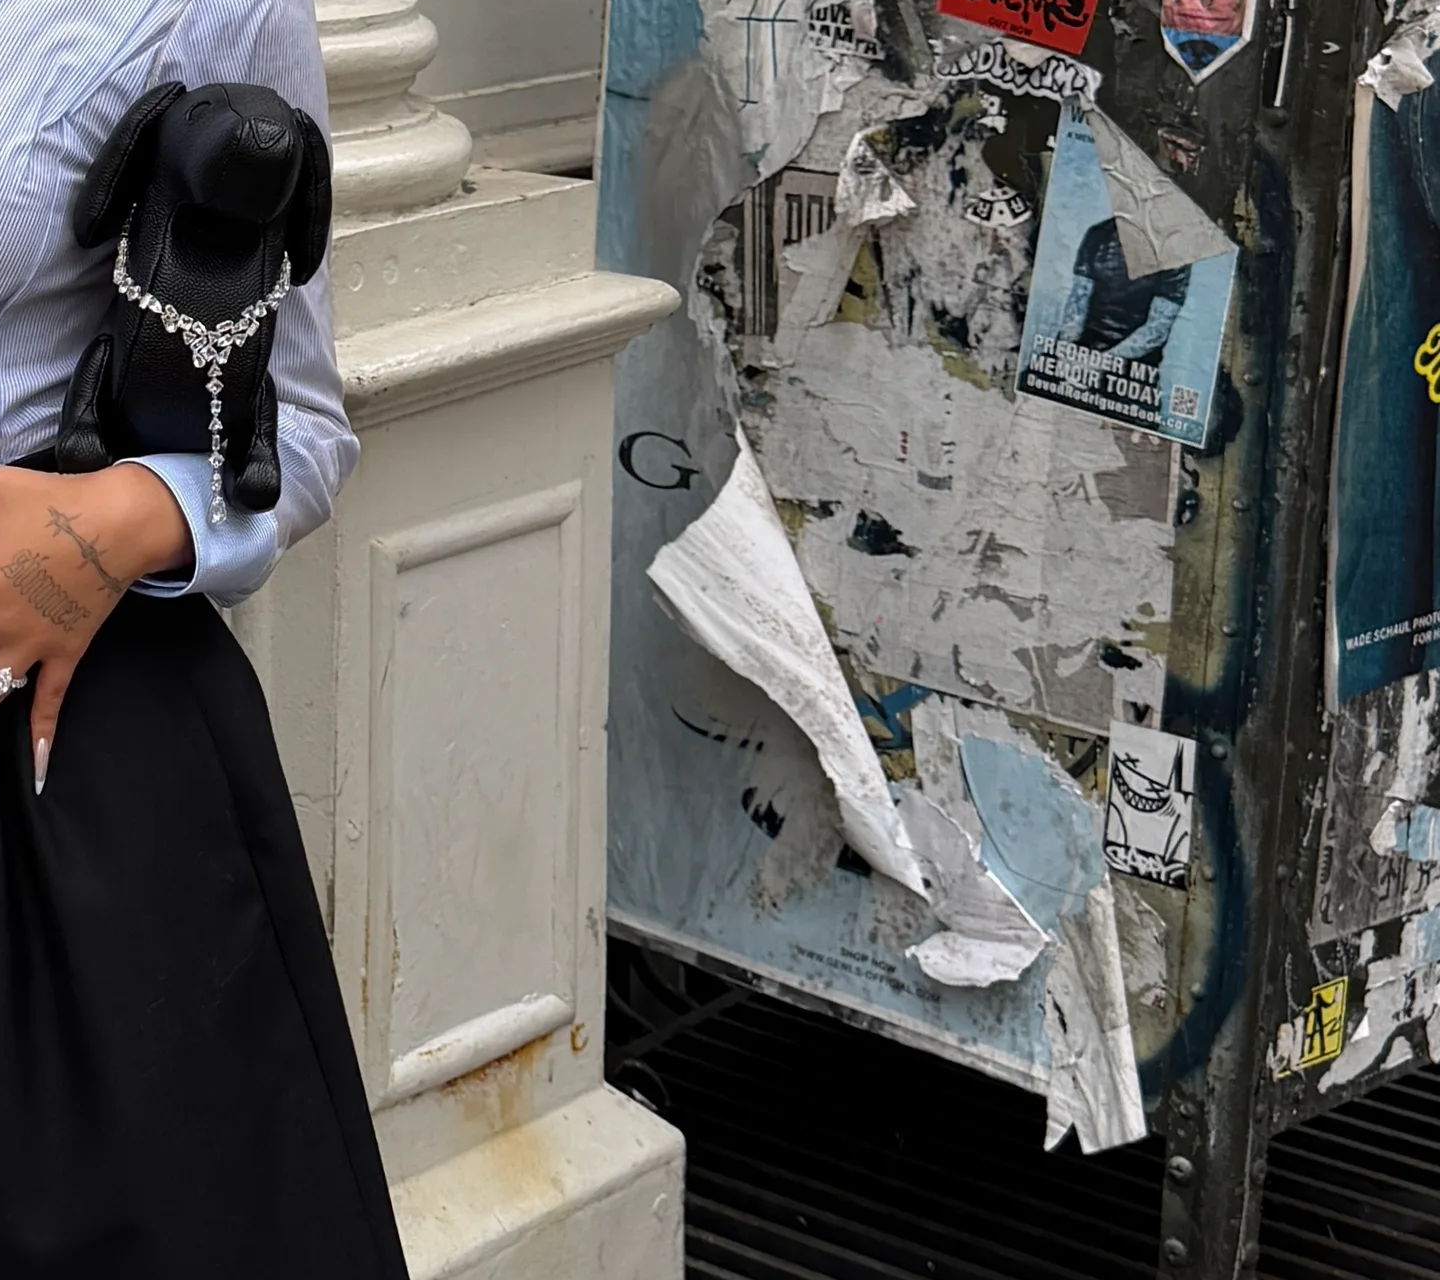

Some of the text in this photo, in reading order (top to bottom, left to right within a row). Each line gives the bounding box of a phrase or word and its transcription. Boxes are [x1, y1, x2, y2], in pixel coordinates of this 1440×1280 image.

[1009, 21, 1033, 37] NOW
[1033, 333, 1160, 385] PREORDER MY
[1029, 353, 1163, 407] MEMOIR TODAY
[1412, 630, 1433, 647] FOR
